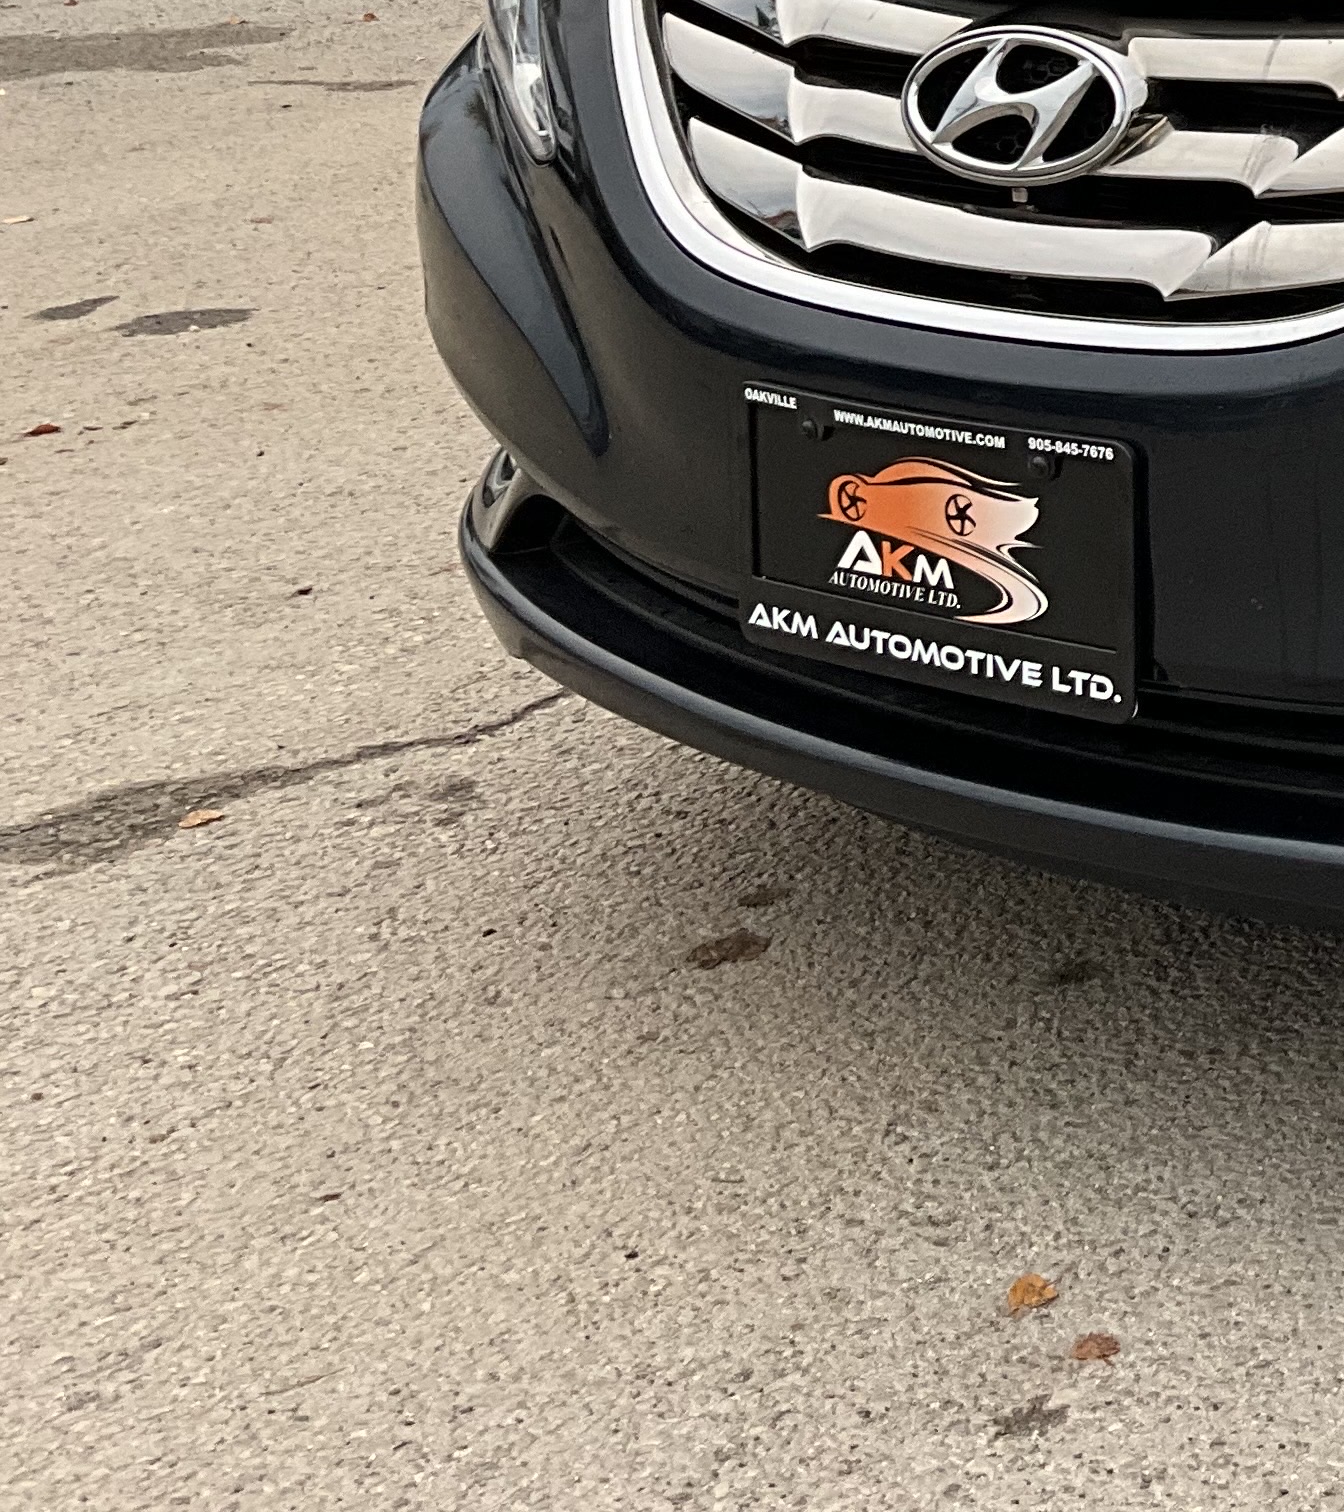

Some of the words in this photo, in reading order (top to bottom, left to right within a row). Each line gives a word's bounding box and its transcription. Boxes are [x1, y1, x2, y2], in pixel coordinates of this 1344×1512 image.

[744, 387, 798, 410] OAKVILLE
[833, 409, 1006, 449] WWW.AKMAUTOMOTIVE.COM
[1028, 436, 1115, 461] 905-845-7676
[838, 530, 955, 590] AKM
[828, 571, 926, 603] AUTOMOTIVE
[928, 588, 961, 610] LTD.
[748, 602, 819, 641] AKM
[825, 621, 1044, 688] AUTOMOTIVE
[1051, 667, 1122, 703] LTD.
